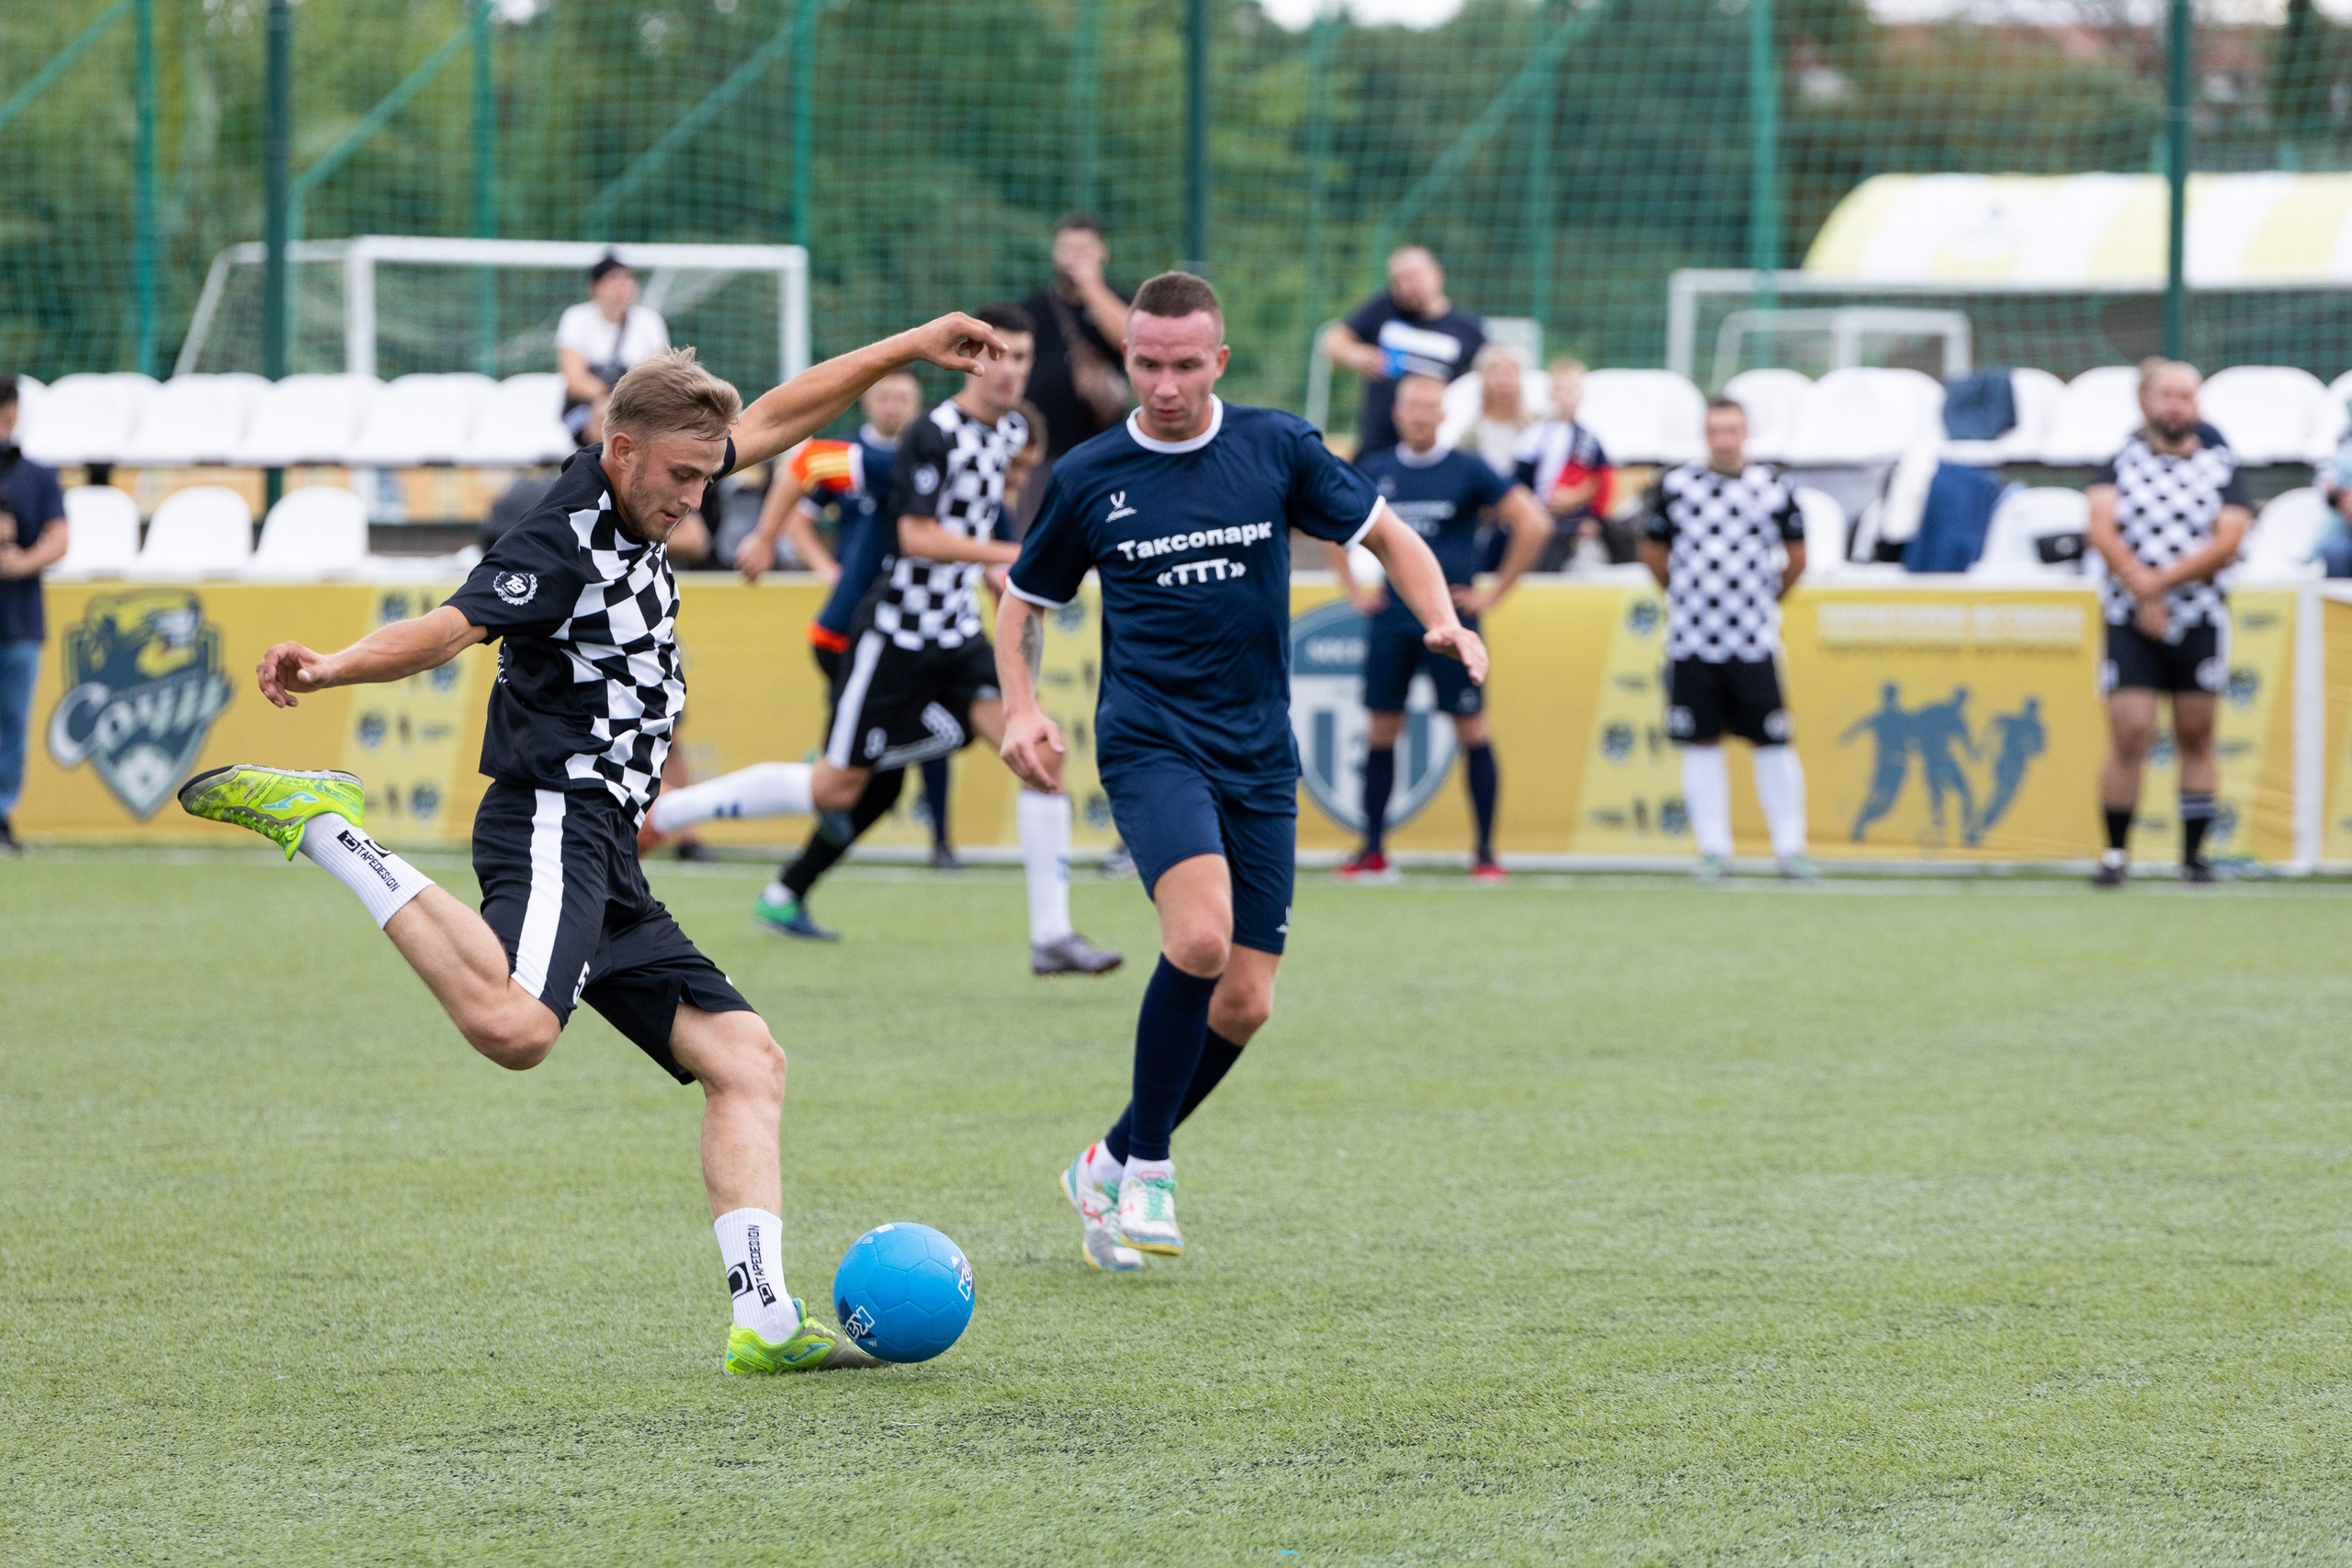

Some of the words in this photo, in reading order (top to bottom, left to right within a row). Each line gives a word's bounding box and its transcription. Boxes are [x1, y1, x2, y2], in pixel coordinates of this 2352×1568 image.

[1117, 521, 1272, 562] Таксопарк
[1156, 558, 1247, 588] «ТТТ»
[356, 846, 401, 892] TAPEDESIGN
[747, 1224, 766, 1284] TAPEDESIGN
